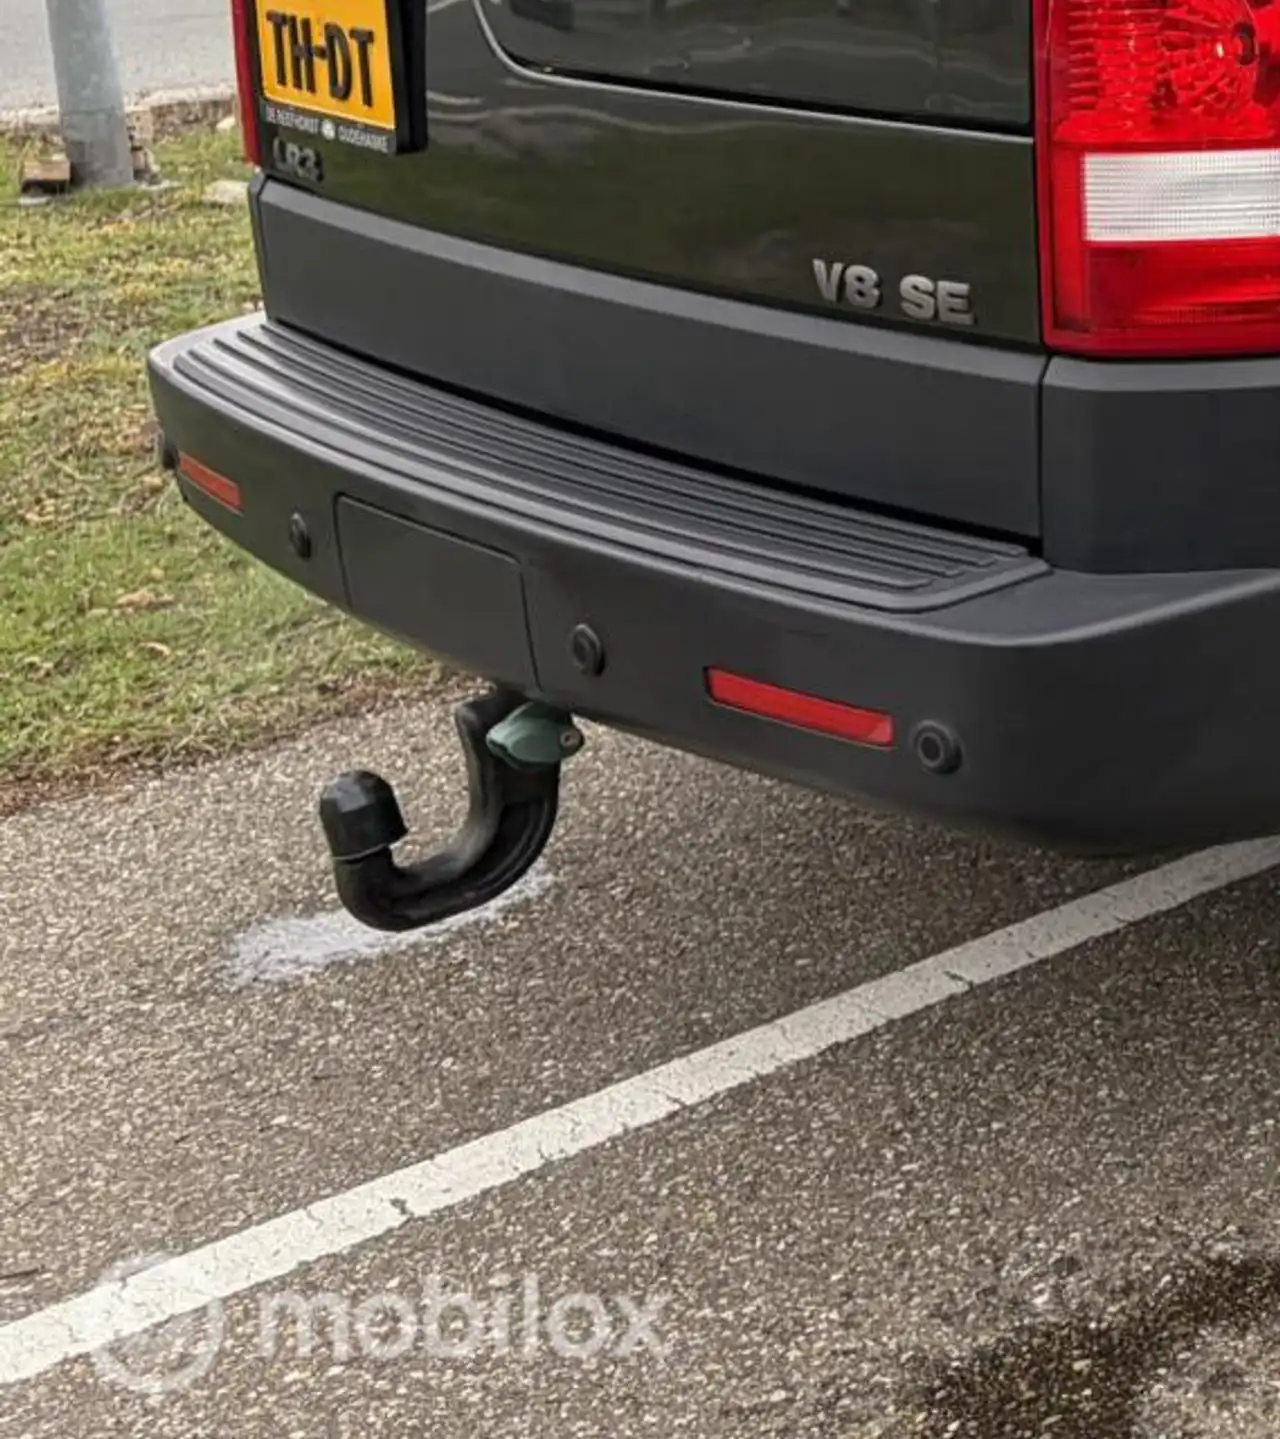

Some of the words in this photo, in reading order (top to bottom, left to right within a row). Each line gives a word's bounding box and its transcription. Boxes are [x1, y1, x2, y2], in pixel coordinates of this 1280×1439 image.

[266, 10, 375, 109] TH-DT
[812, 259, 884, 309] V8
[900, 274, 976, 325] SE
